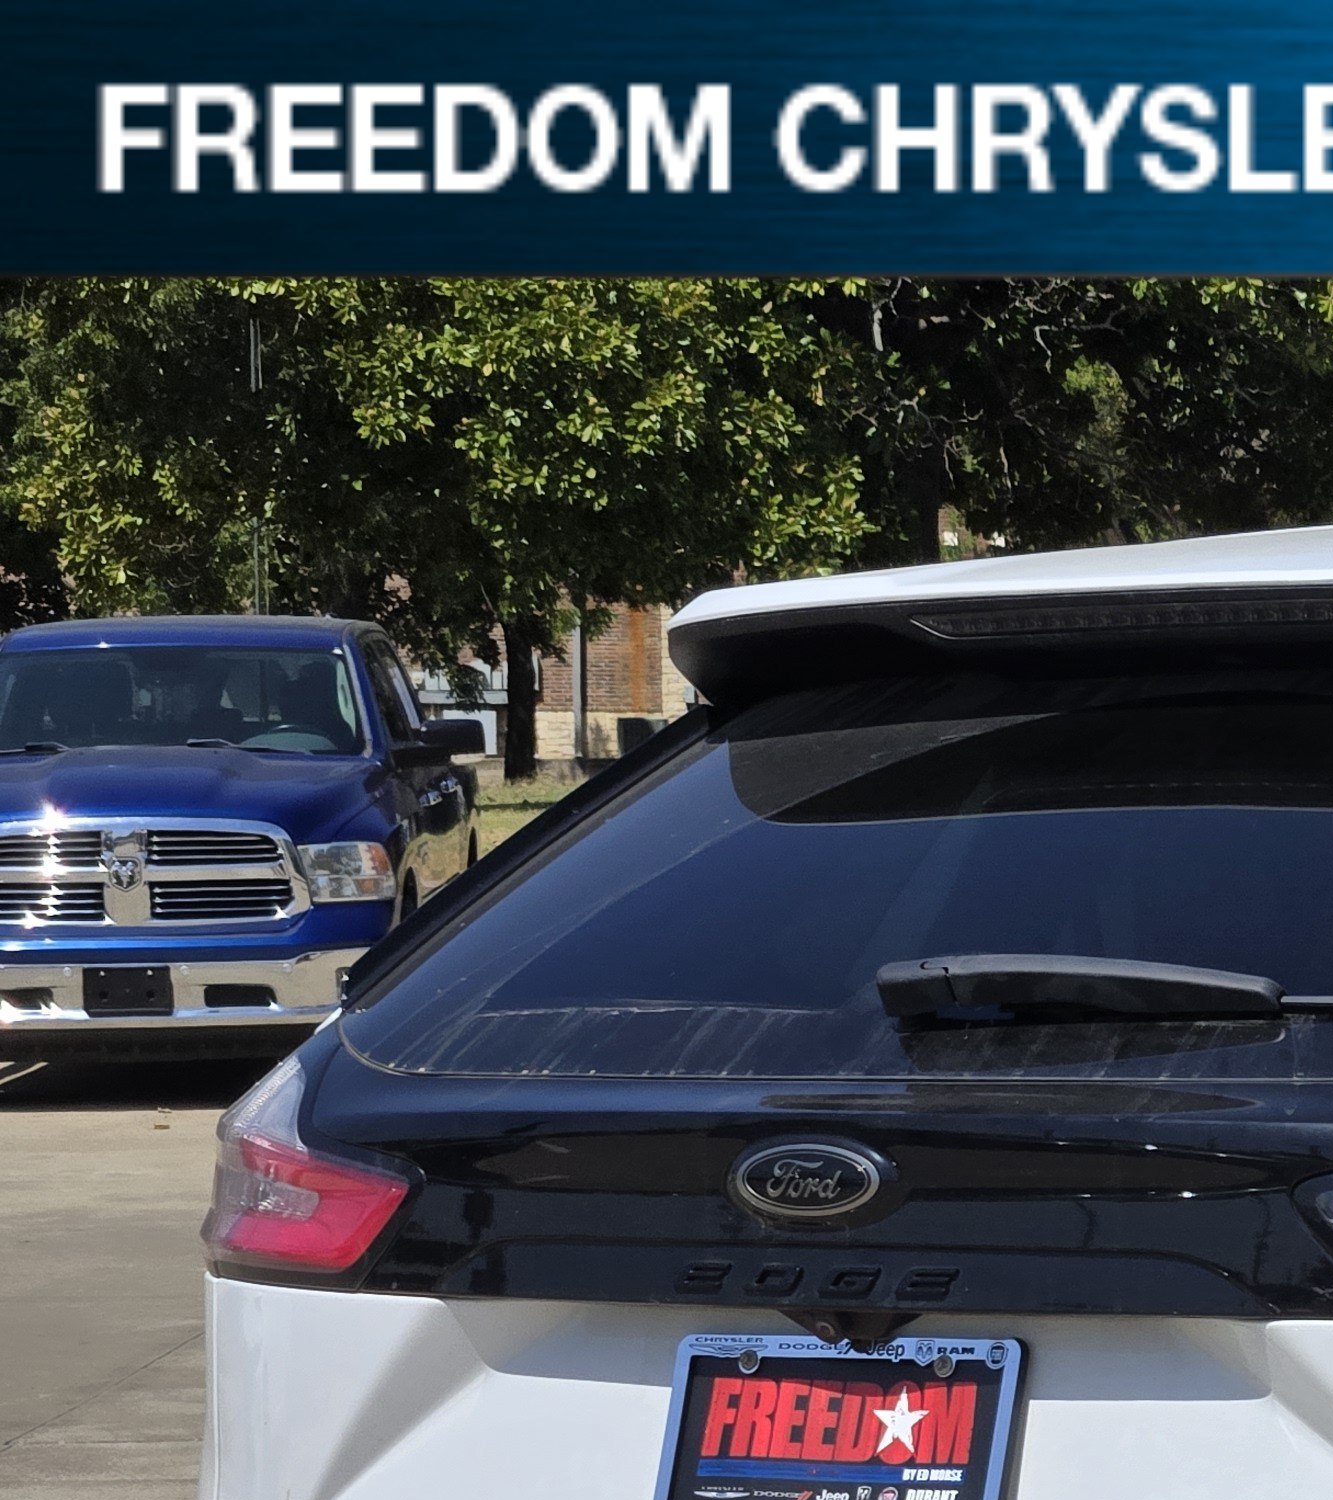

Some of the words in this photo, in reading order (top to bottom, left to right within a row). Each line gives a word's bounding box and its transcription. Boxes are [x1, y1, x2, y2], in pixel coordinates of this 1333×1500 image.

[766, 1158, 842, 1200] Ford
[676, 1261, 961, 1300] EDGE
[694, 1336, 765, 1344] CHRYSLER
[866, 1341, 906, 1360] Jeep
[936, 1346, 976, 1355] RAM
[700, 1376, 978, 1466] FREEDOM
[901, 1468, 918, 1481] BY
[916, 1468, 930, 1481] ED
